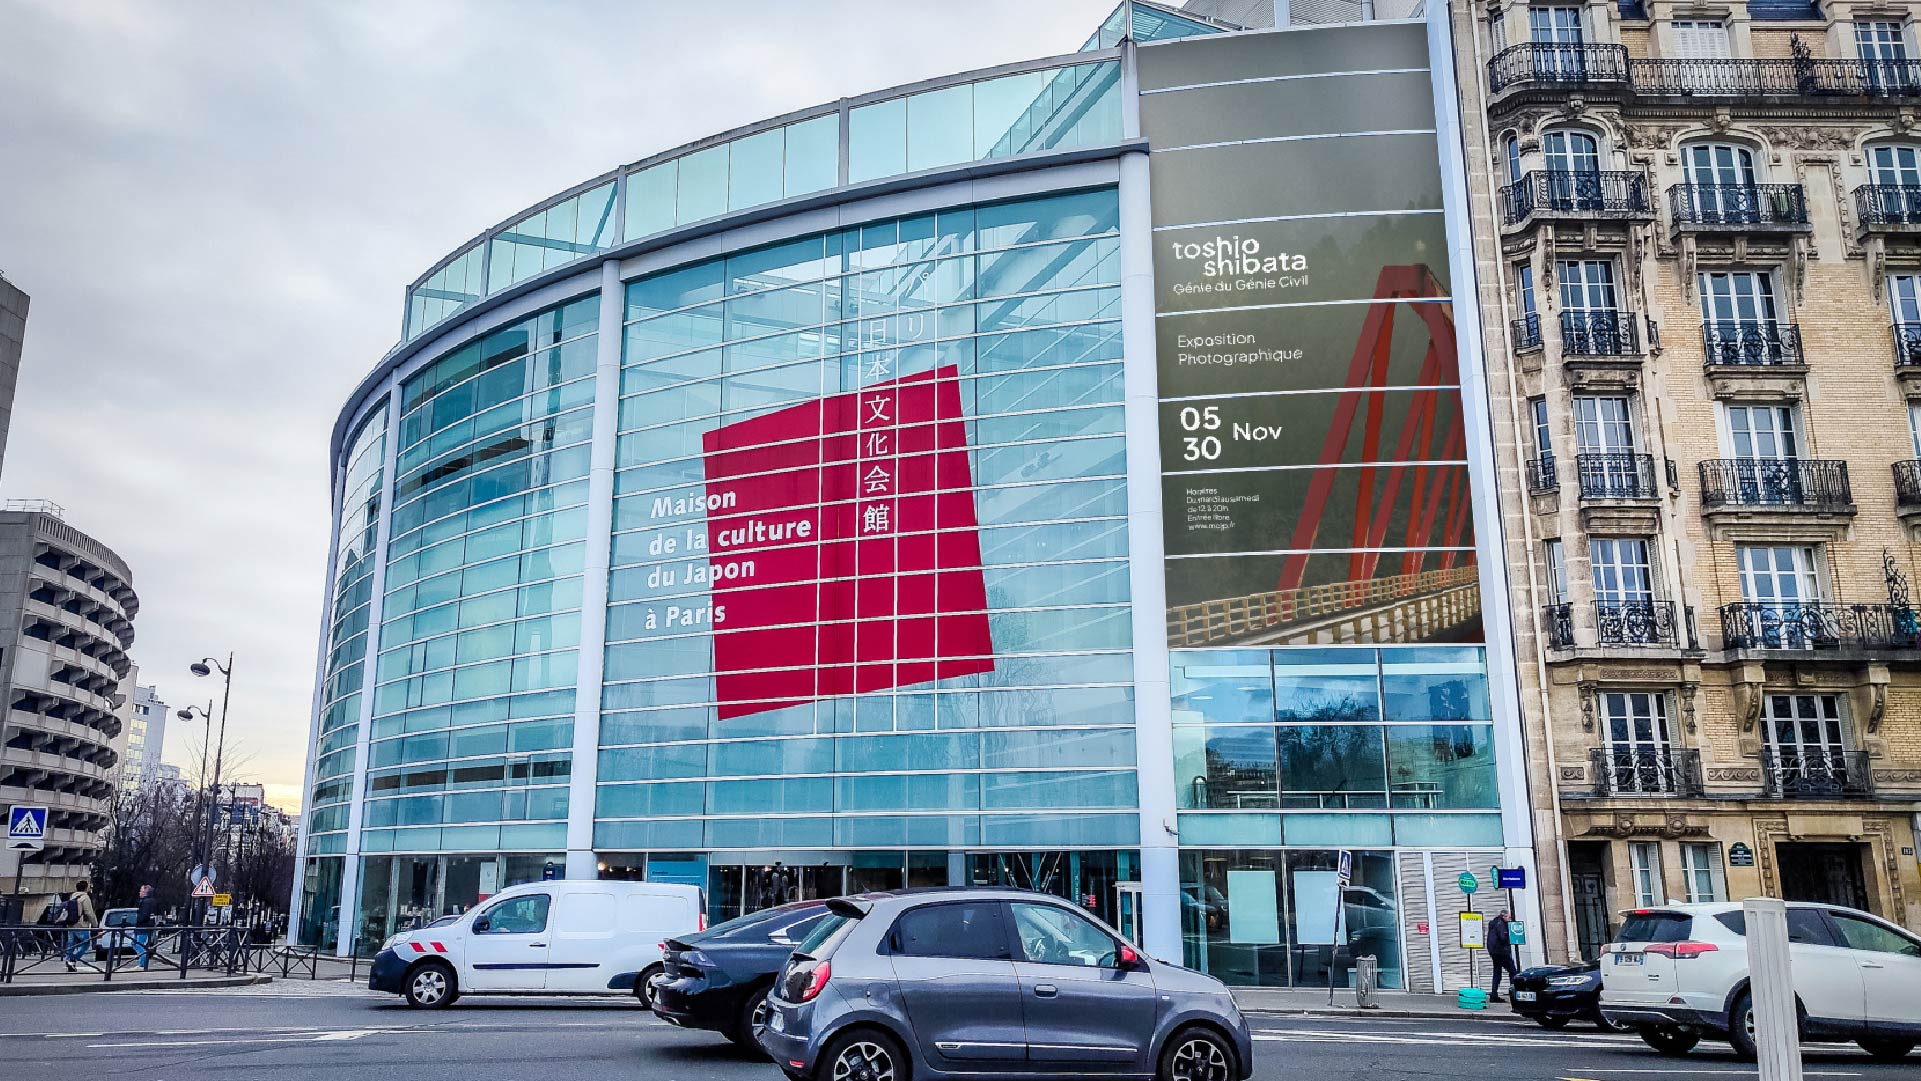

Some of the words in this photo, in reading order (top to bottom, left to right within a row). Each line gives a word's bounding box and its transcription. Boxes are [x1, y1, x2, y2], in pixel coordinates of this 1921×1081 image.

[1172, 236, 1260, 260] toshio
[1203, 252, 1308, 276] shibata
[1173, 282, 1212, 295] Génie
[1215, 280, 1232, 291] du
[1235, 278, 1276, 291] Génie
[1279, 274, 1309, 288] Civil
[1177, 333, 1256, 349] Exposition
[1178, 348, 1303, 366] Photographique
[1180, 406, 1221, 431] 05
[1233, 422, 1282, 441] Nov
[1183, 436, 1222, 461] 30
[650, 490, 737, 519] Maison
[649, 533, 677, 556] de
[686, 529, 707, 550] la
[717, 518, 812, 547] culture
[647, 566, 675, 588] du
[683, 560, 755, 588] Japon
[645, 608, 657, 630] à
[665, 601, 726, 628] Paris
